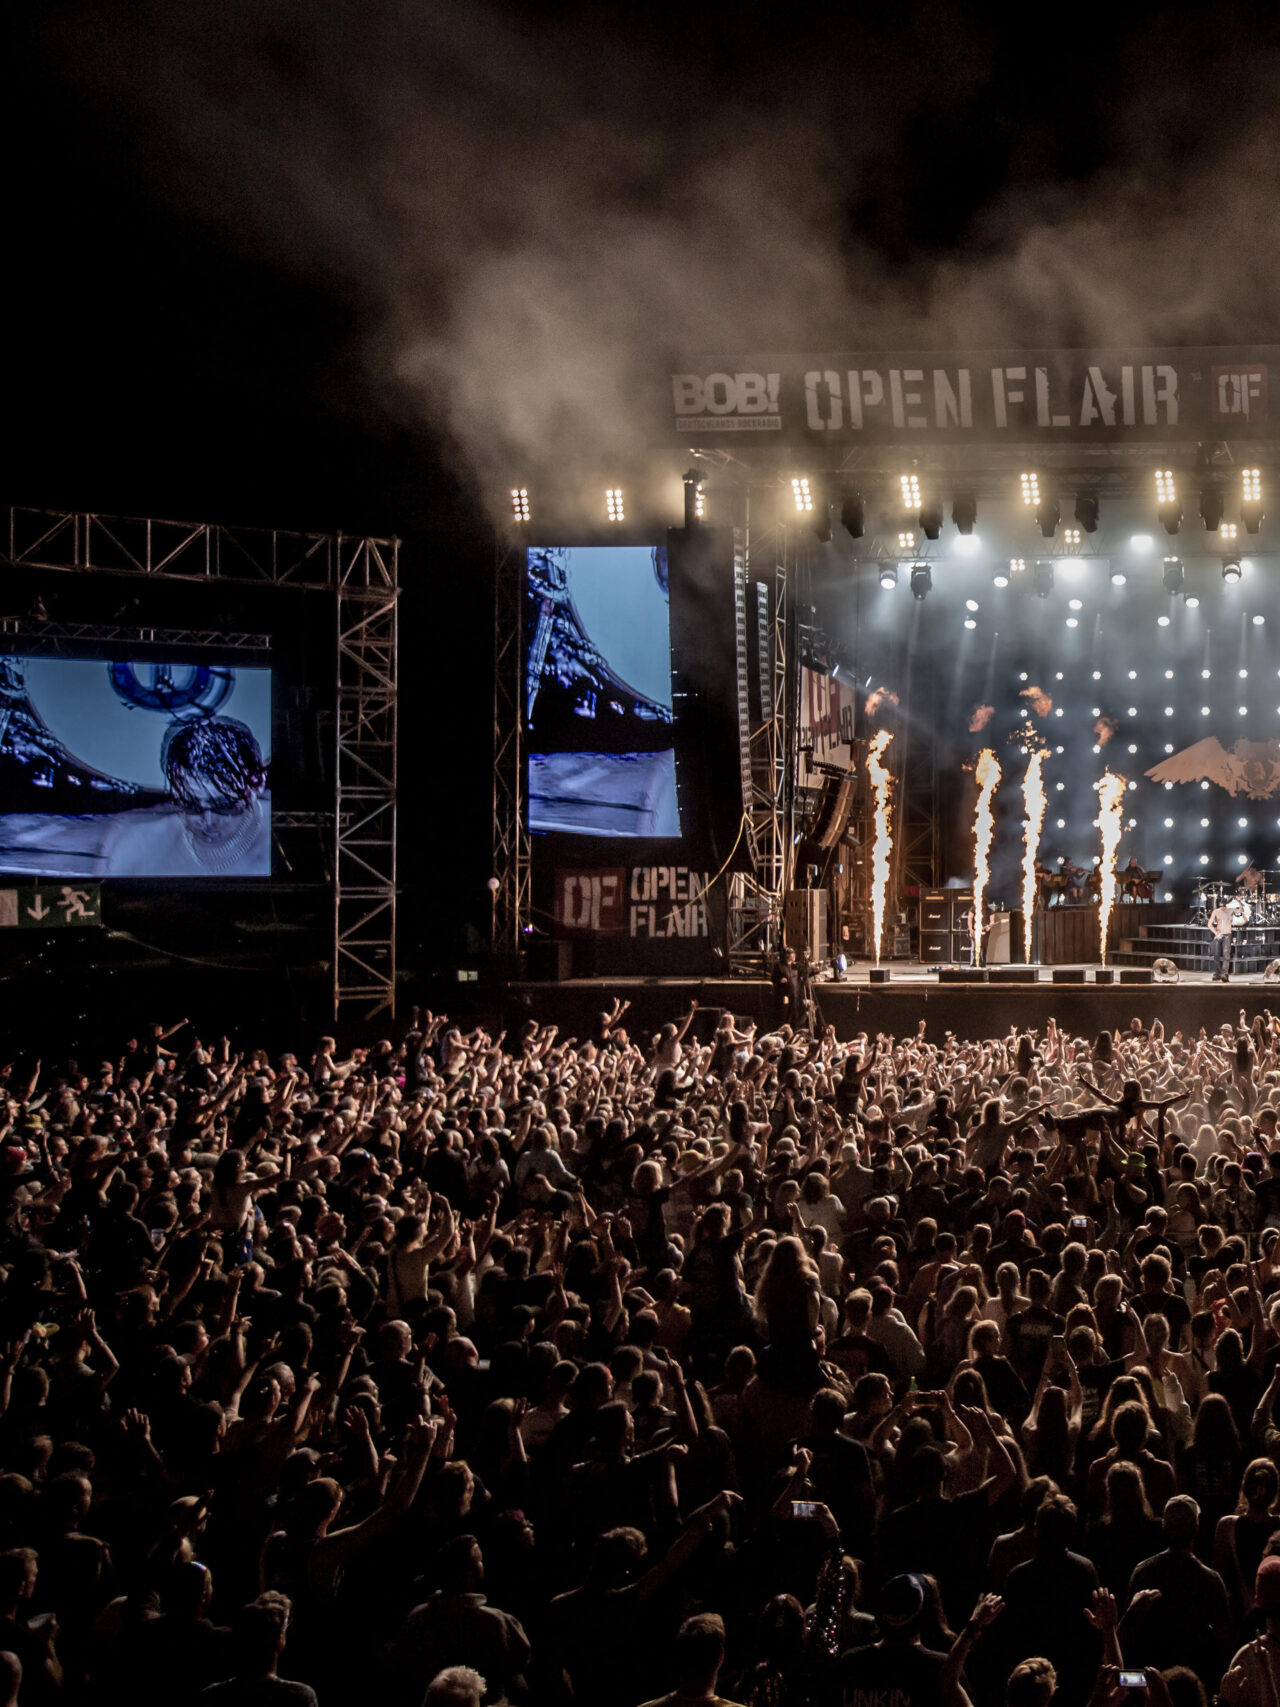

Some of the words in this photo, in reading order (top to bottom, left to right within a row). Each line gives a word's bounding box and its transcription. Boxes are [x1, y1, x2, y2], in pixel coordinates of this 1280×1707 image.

[672, 373, 780, 414] BOB!
[804, 368, 973, 431] OPEN
[992, 365, 1181, 428] FLAIR
[1219, 373, 1262, 421] OF
[563, 875, 618, 930] OF
[630, 866, 709, 901] OPEN
[630, 905, 709, 938] FLAIR
[842, 1685, 912, 1707] LINKIN
